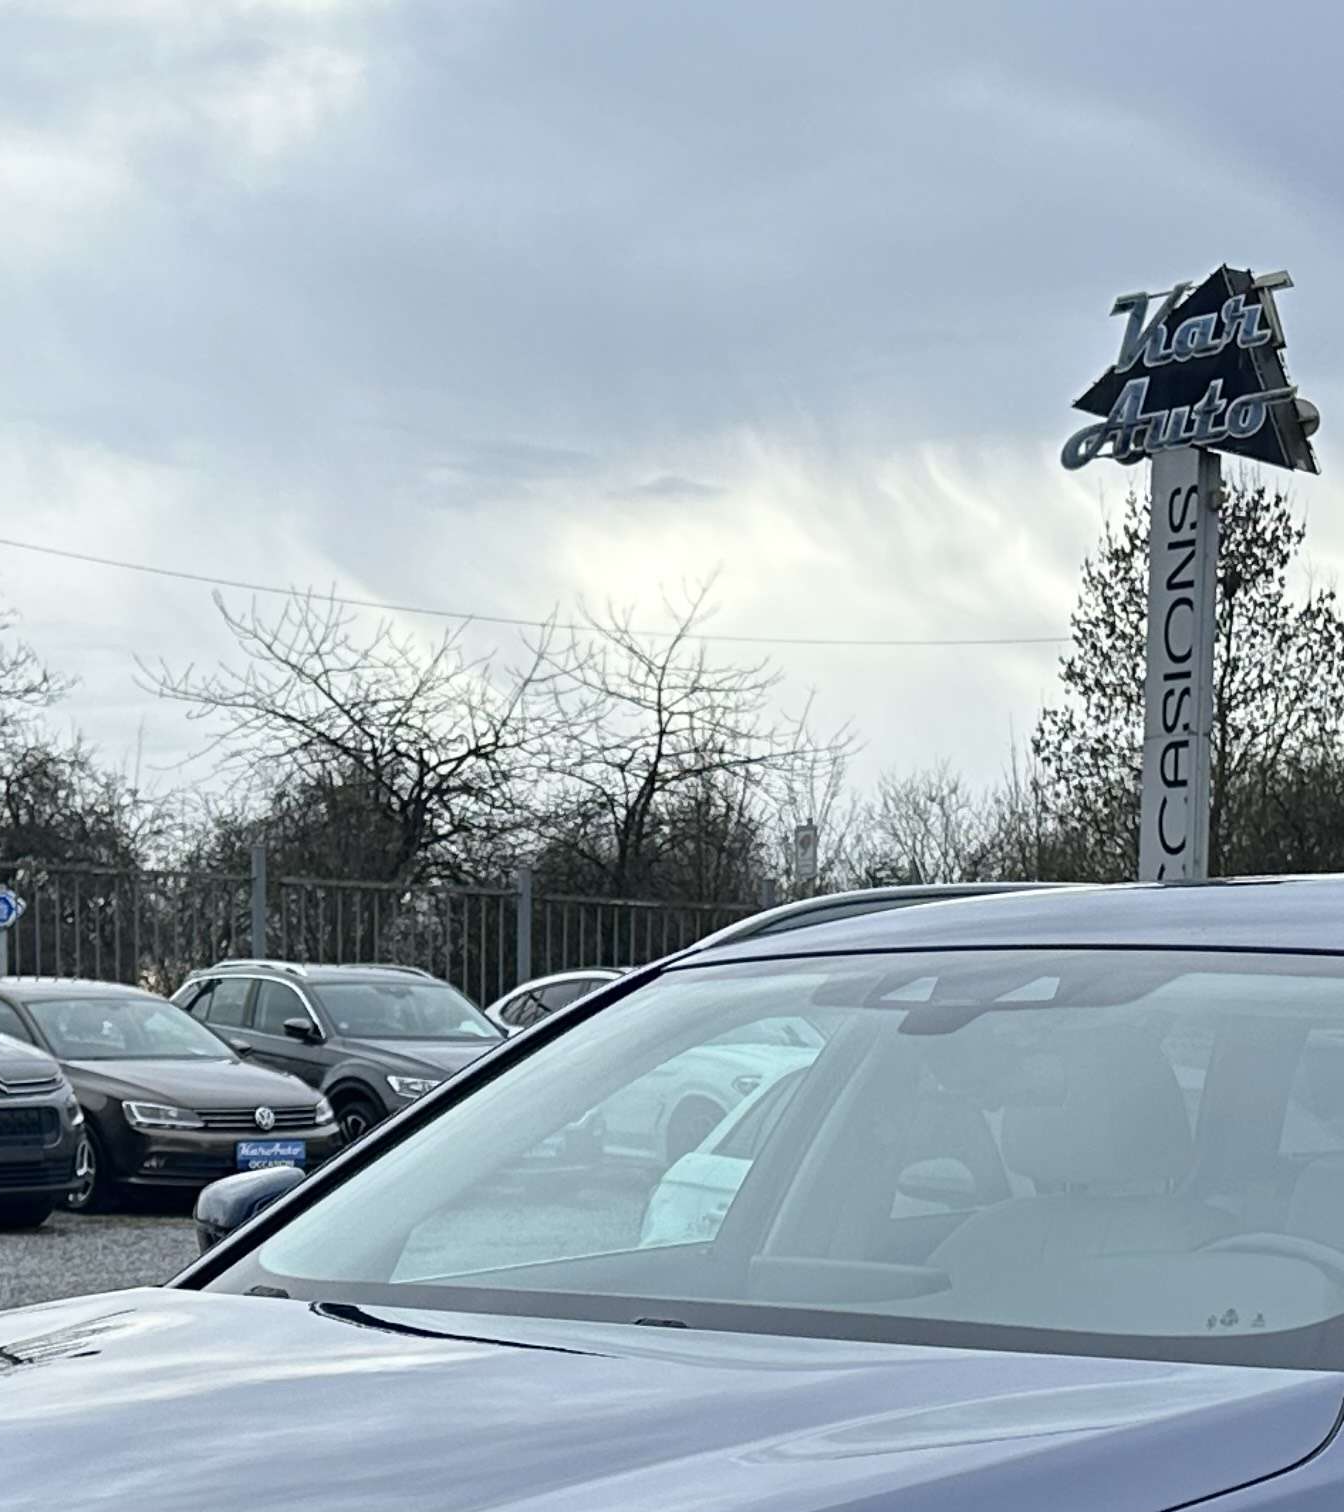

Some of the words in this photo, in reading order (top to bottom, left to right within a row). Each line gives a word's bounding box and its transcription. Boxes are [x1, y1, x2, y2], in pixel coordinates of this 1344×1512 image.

[1109, 281, 1272, 374] Kar
[1061, 376, 1299, 470] Auto
[1157, 485, 1200, 881] CASIONS
